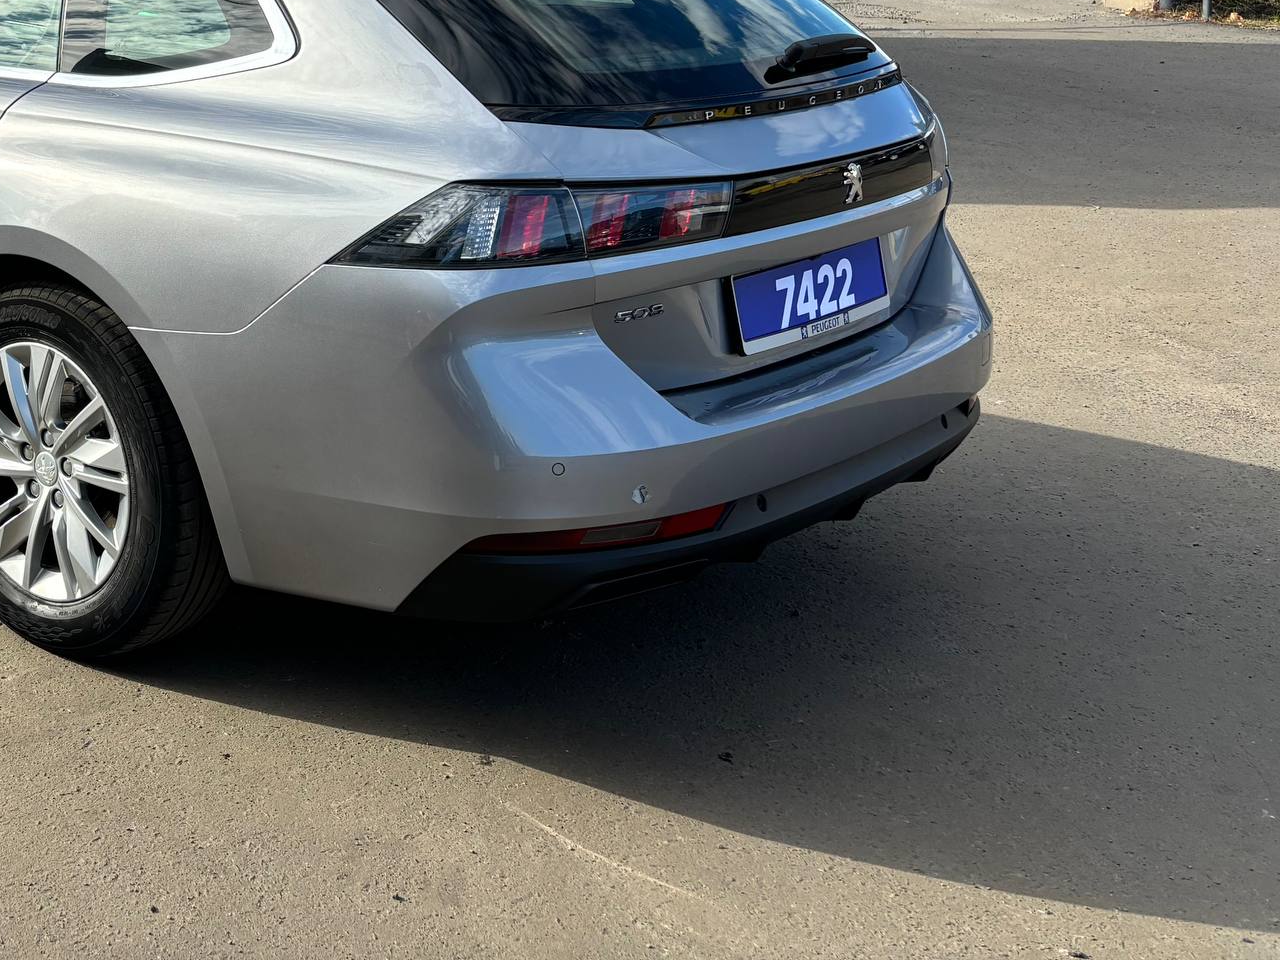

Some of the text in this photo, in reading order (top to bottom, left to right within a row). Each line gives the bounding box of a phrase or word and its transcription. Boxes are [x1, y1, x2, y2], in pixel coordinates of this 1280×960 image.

[704, 80, 885, 121] PEUGEOT
[775, 257, 856, 330] 7422
[811, 316, 840, 334] PEUGEOT
